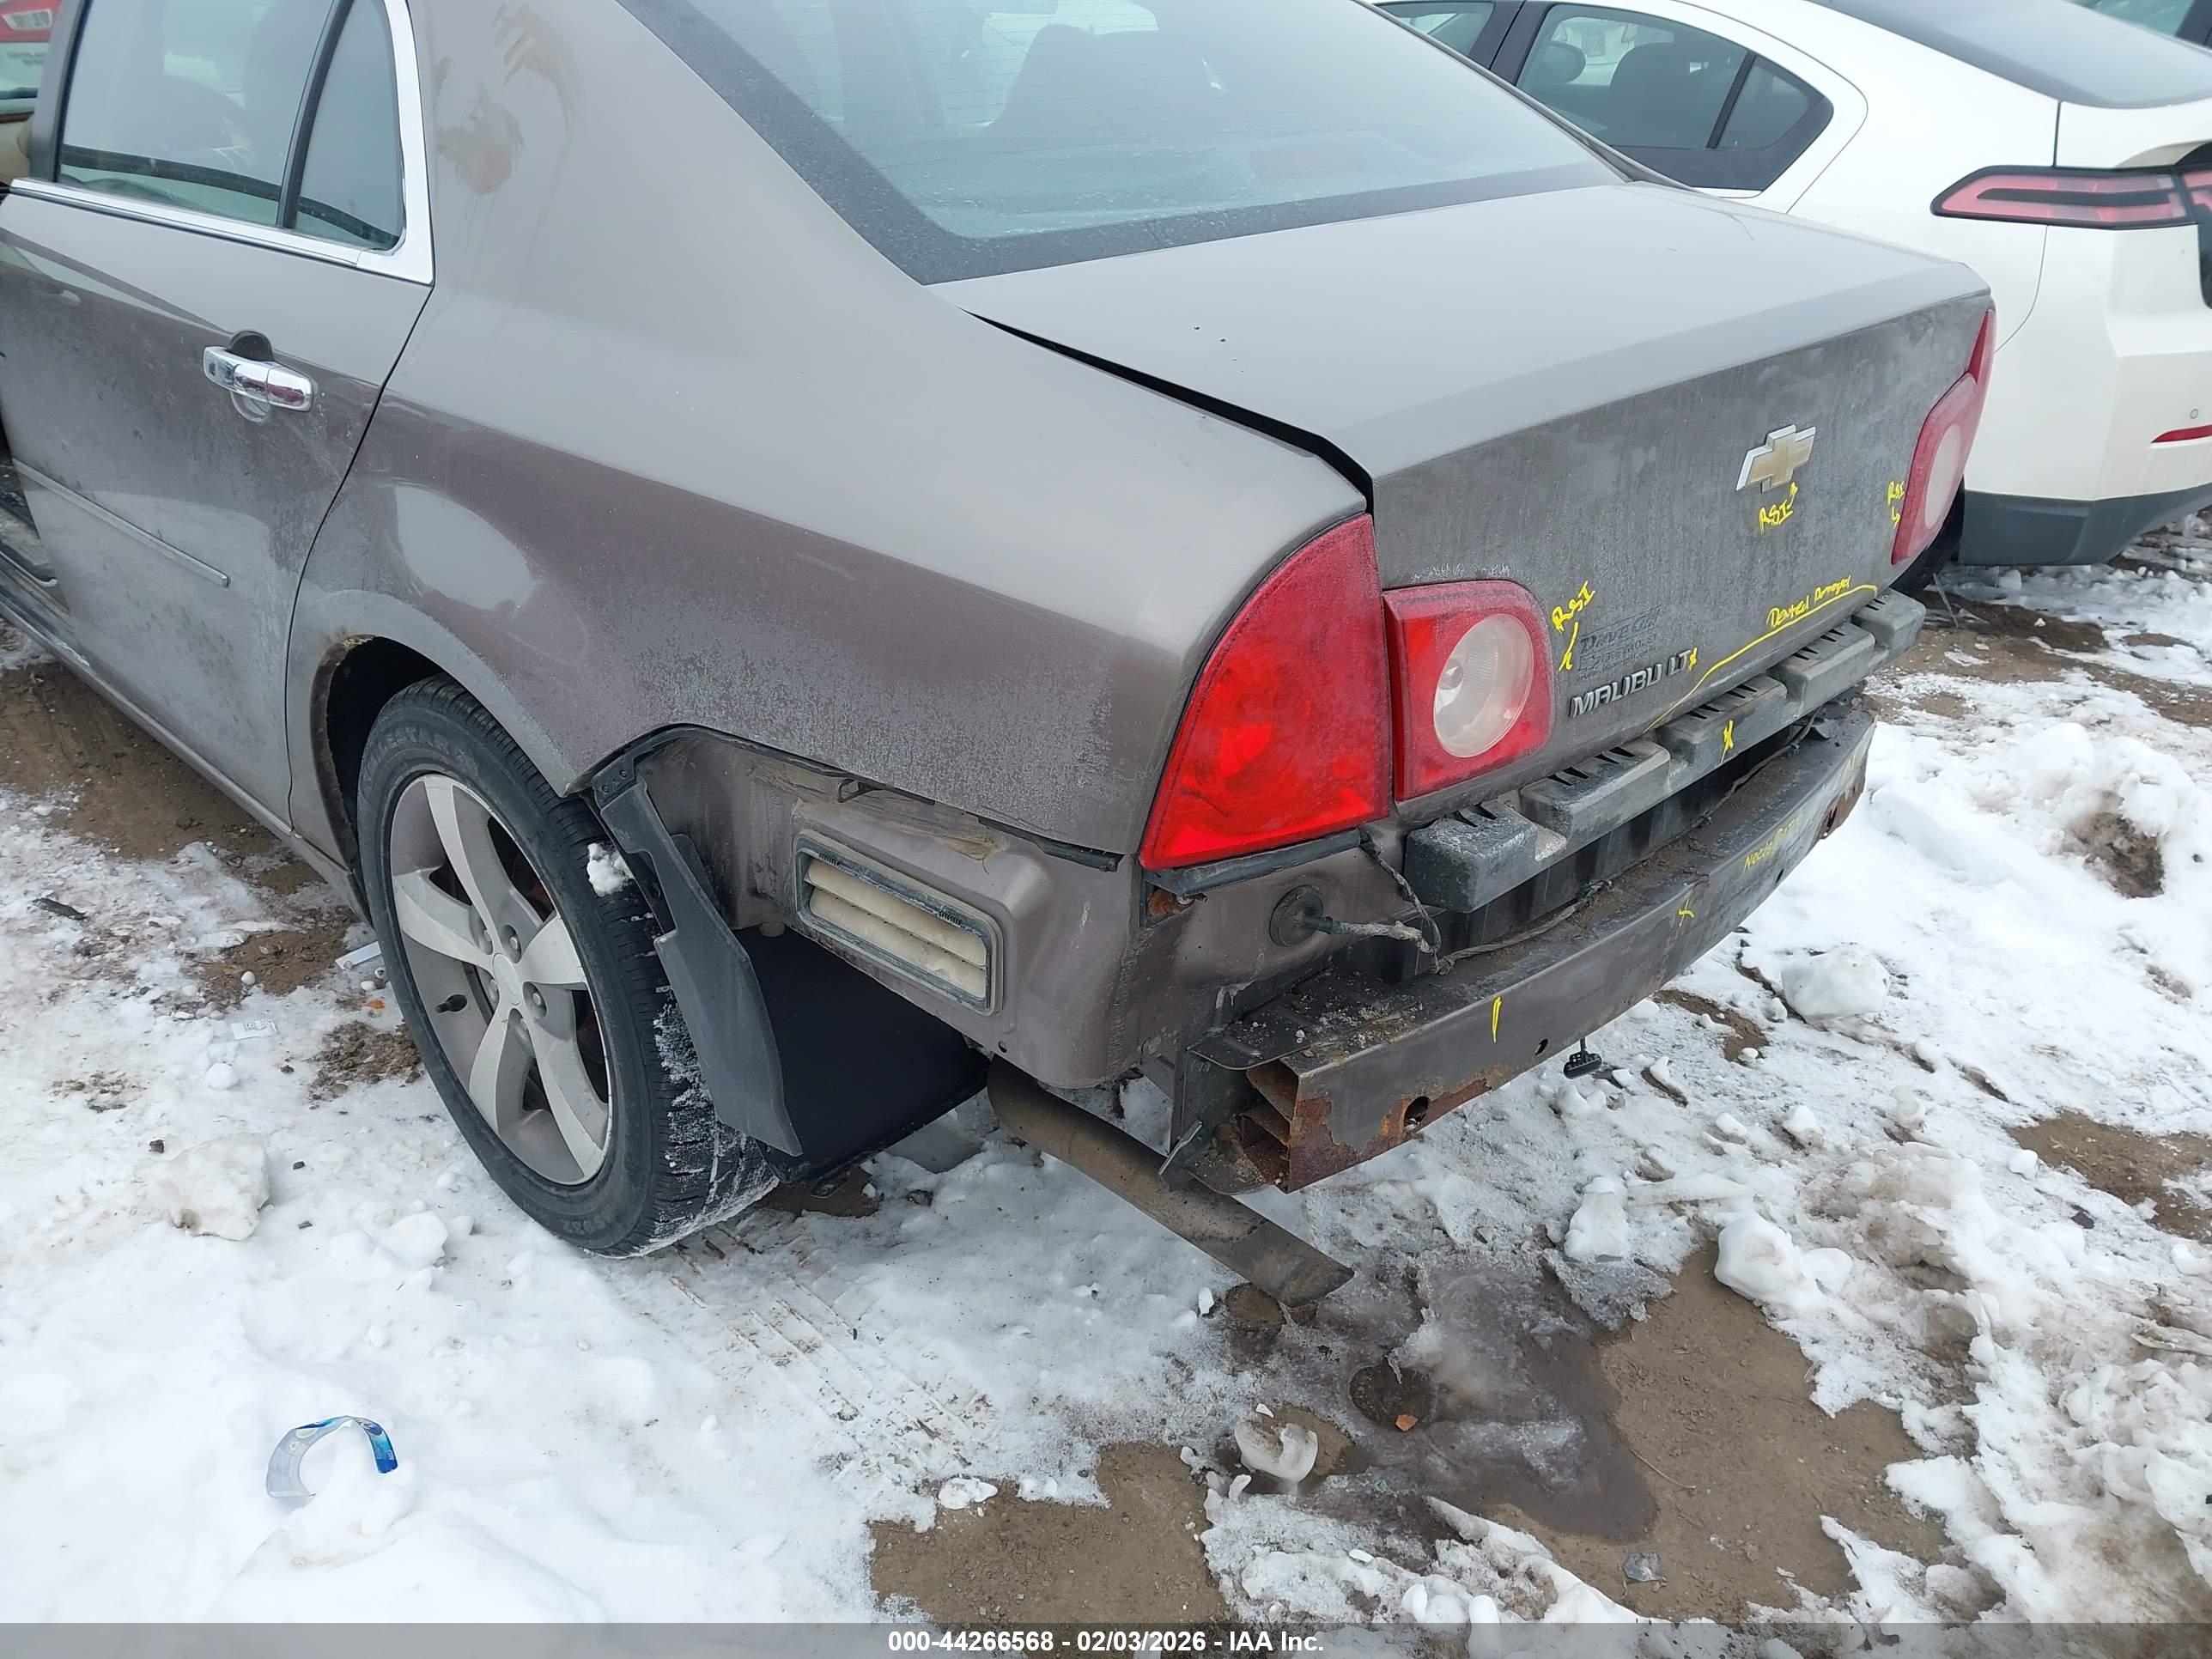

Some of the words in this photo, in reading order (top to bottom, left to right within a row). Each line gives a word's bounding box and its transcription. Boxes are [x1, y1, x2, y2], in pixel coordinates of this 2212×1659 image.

[1759, 499, 1794, 535] RSI
[1552, 580, 1595, 634] RSI
[1568, 663, 1662, 718] MALIBU
[1667, 649, 1692, 677] LT
